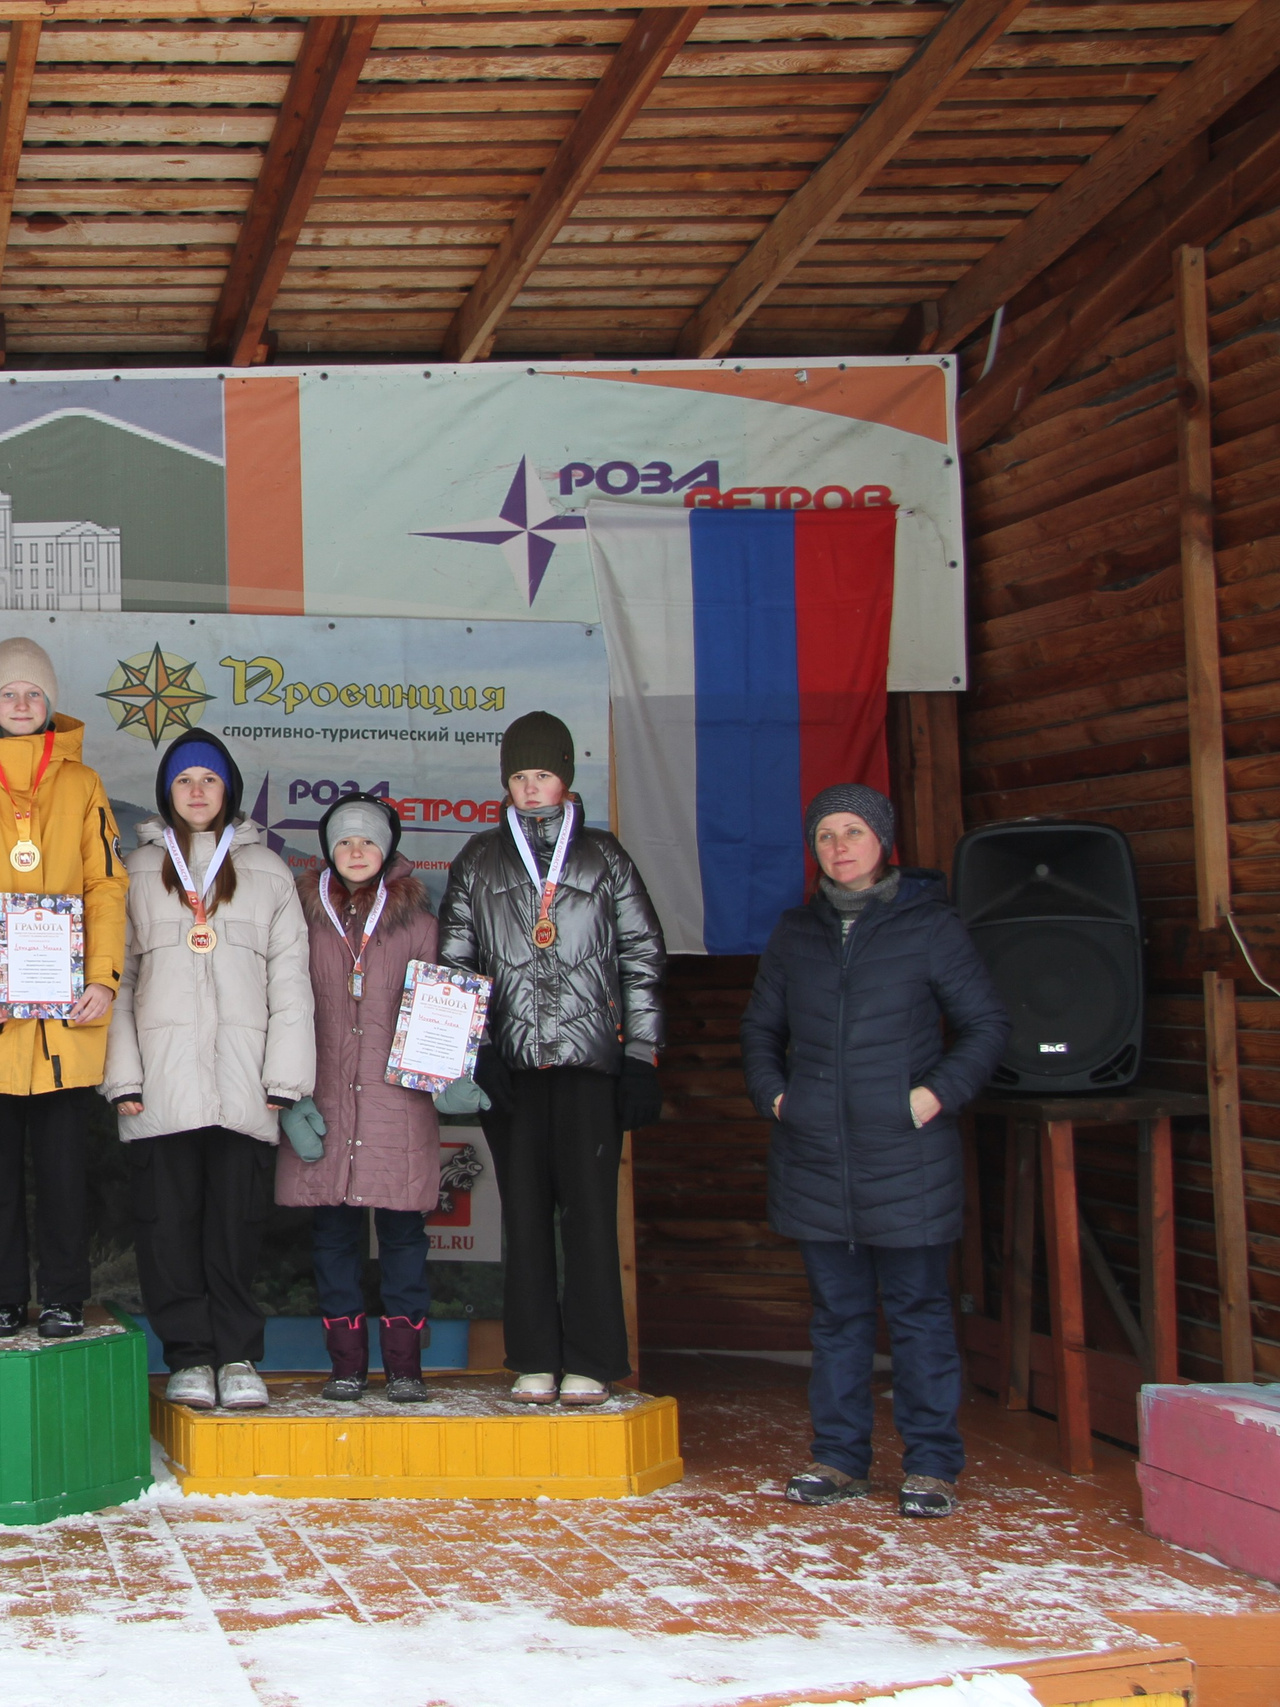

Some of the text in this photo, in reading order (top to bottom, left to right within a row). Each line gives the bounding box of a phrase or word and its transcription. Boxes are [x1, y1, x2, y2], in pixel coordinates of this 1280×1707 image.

[559, 460, 719, 495] РОЗА
[219, 656, 505, 715] Провинция
[222, 725, 505, 746] спортивно-туристический центр
[411, 860, 452, 870] иенти
[14, 922, 64, 932] ГРАМОТА
[421, 993, 468, 1010] ГРАМОТА
[429, 1235, 474, 1250] EL.RU
